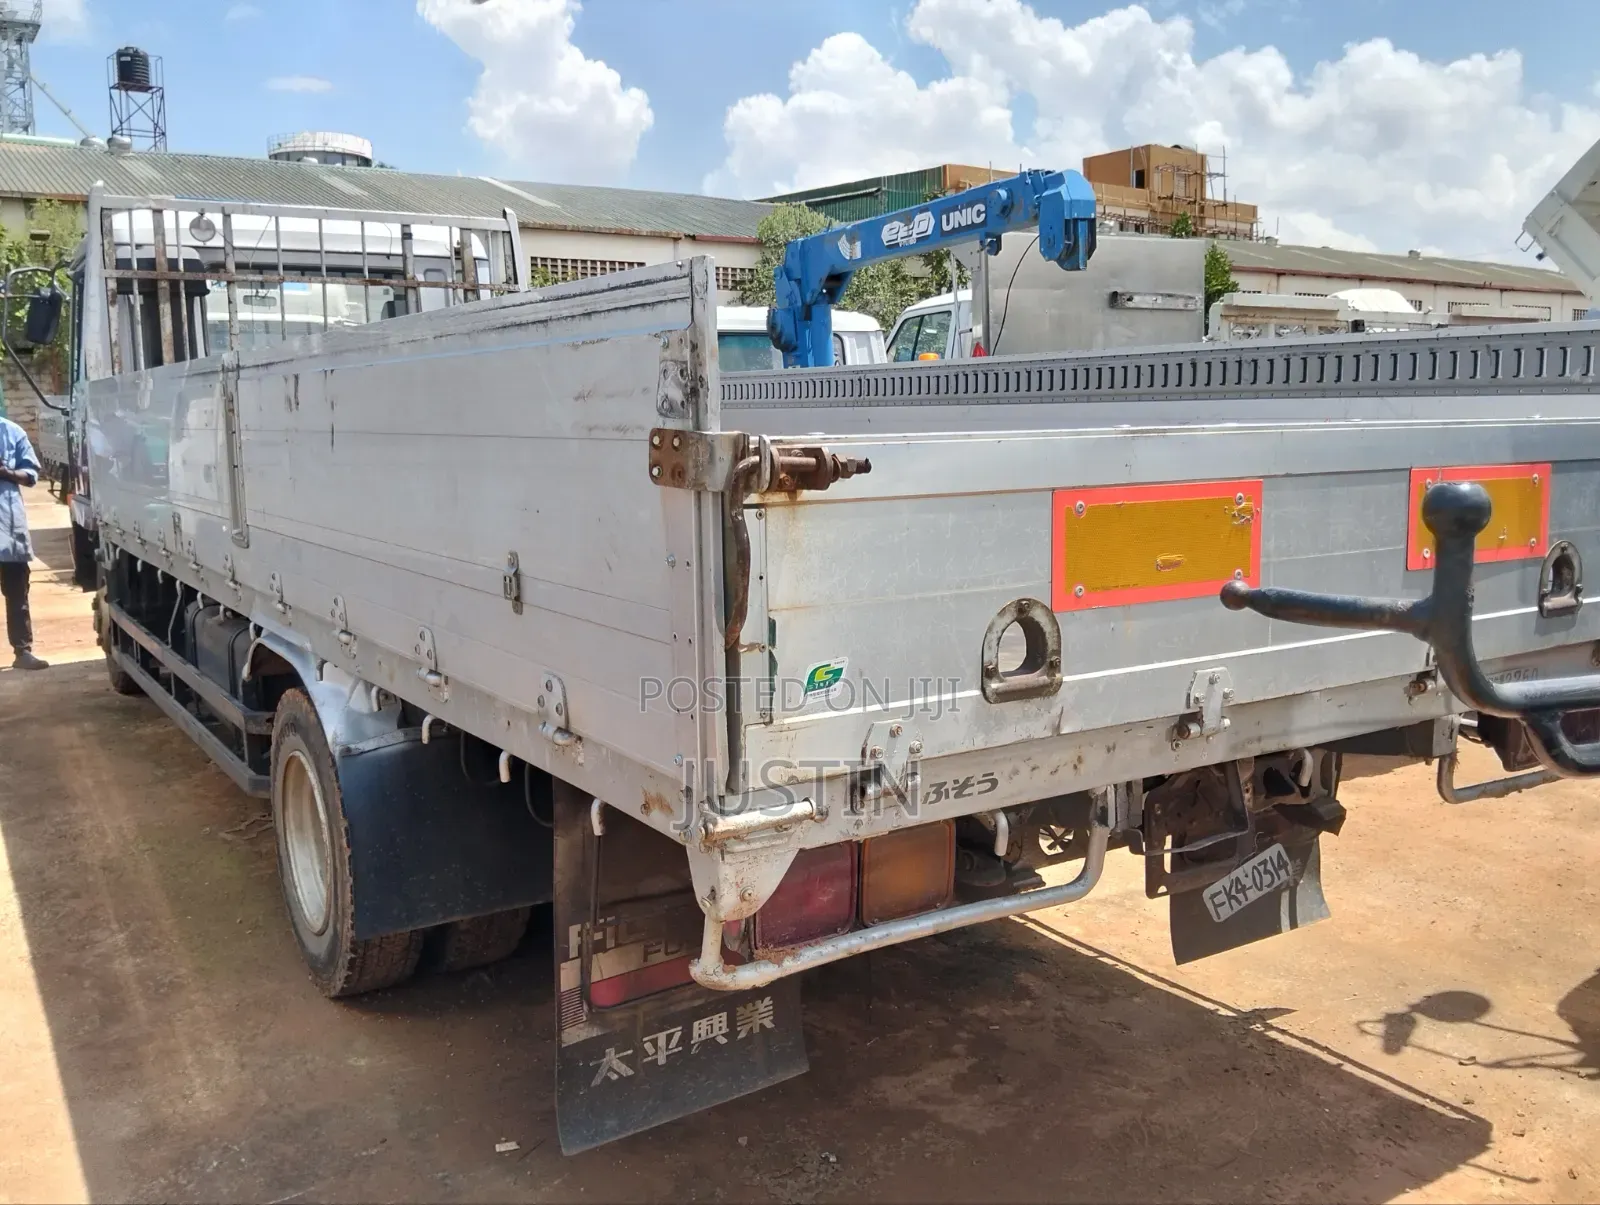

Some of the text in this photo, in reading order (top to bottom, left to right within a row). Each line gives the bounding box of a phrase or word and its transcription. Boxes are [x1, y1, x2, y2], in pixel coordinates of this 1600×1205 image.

[941, 204, 986, 232] UNIC
[921, 771, 999, 805] ふそう
[589, 996, 776, 1088] 太平興業
